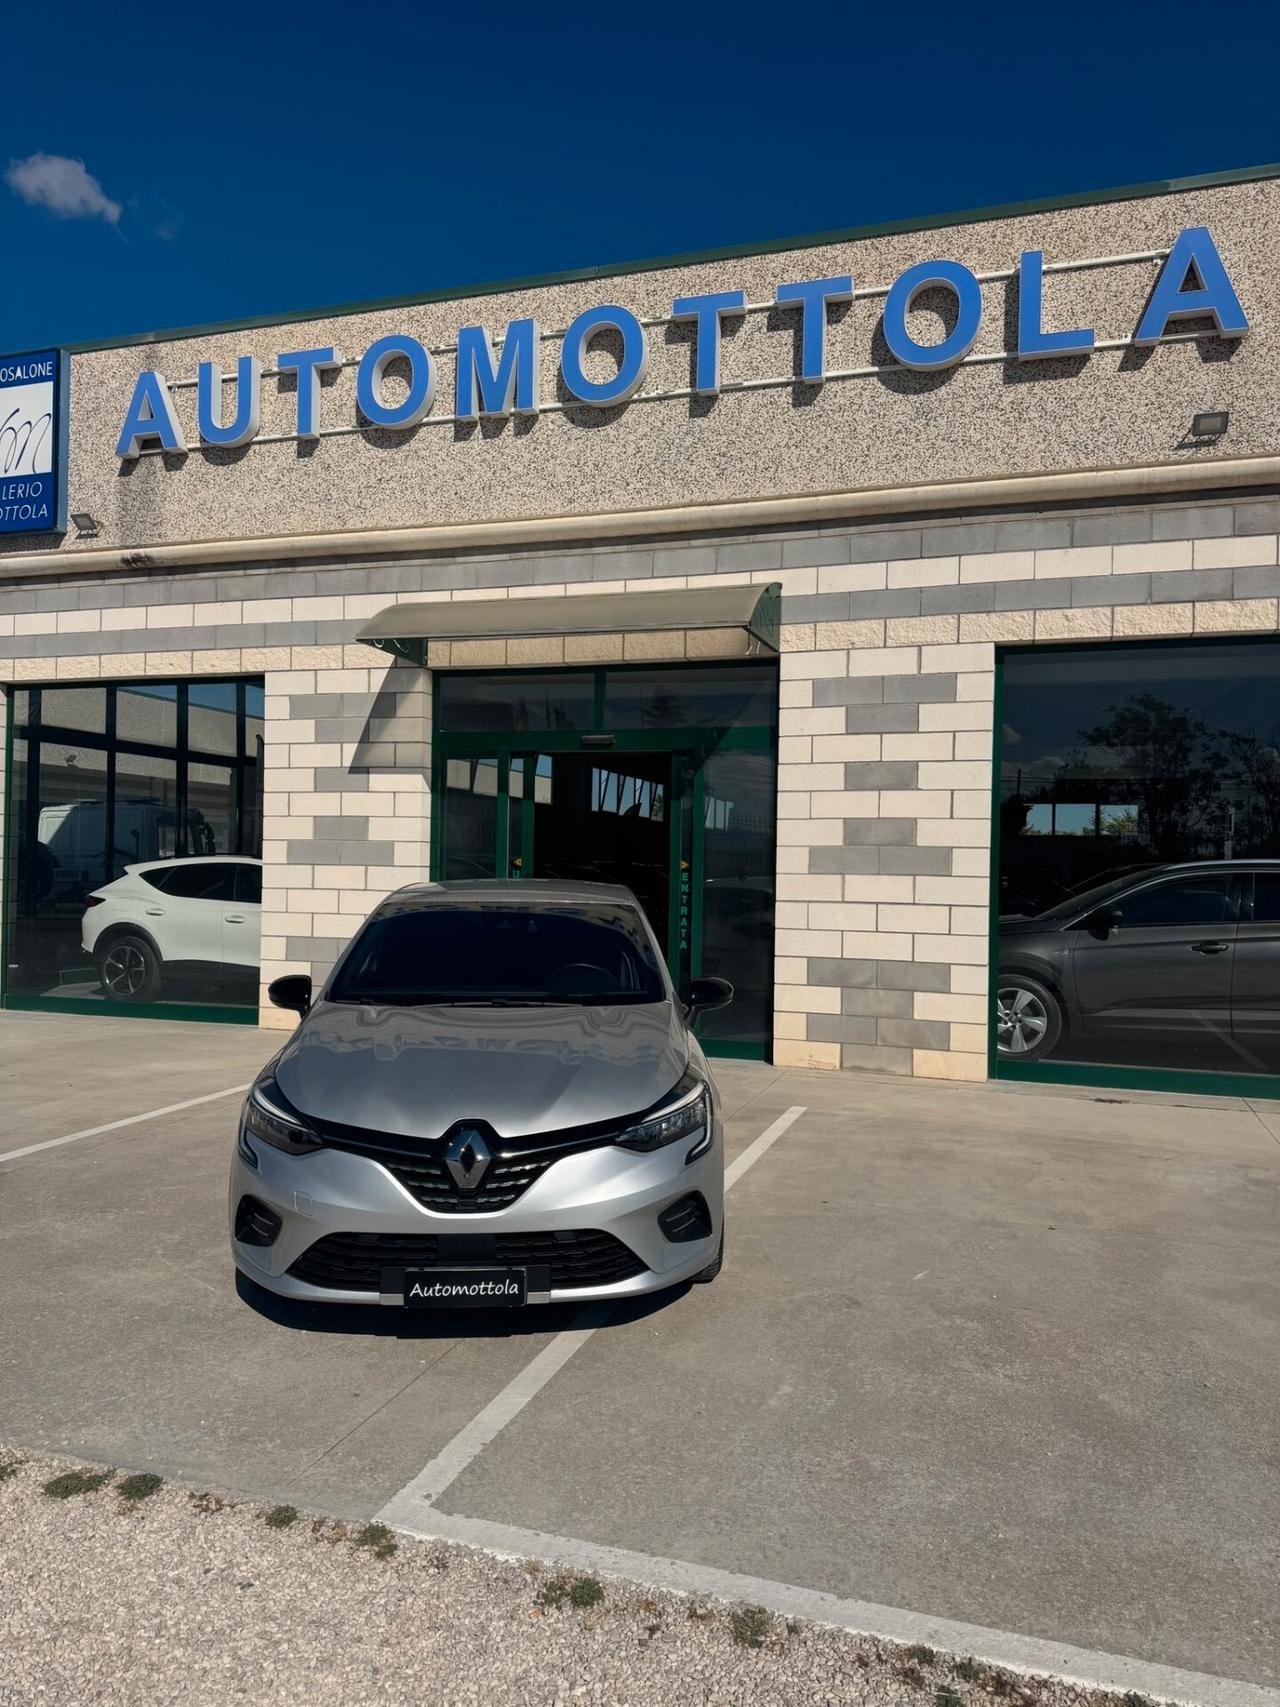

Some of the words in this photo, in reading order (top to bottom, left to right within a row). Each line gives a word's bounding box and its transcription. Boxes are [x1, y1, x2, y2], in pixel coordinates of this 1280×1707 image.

[115, 226, 1249, 459] AUTOMOTTOLA
[0, 361, 53, 382] OSALONE
[2, 481, 43, 500] LERIO
[680, 872, 689, 949] ENTRATA
[409, 1279, 519, 1298] Automottola
